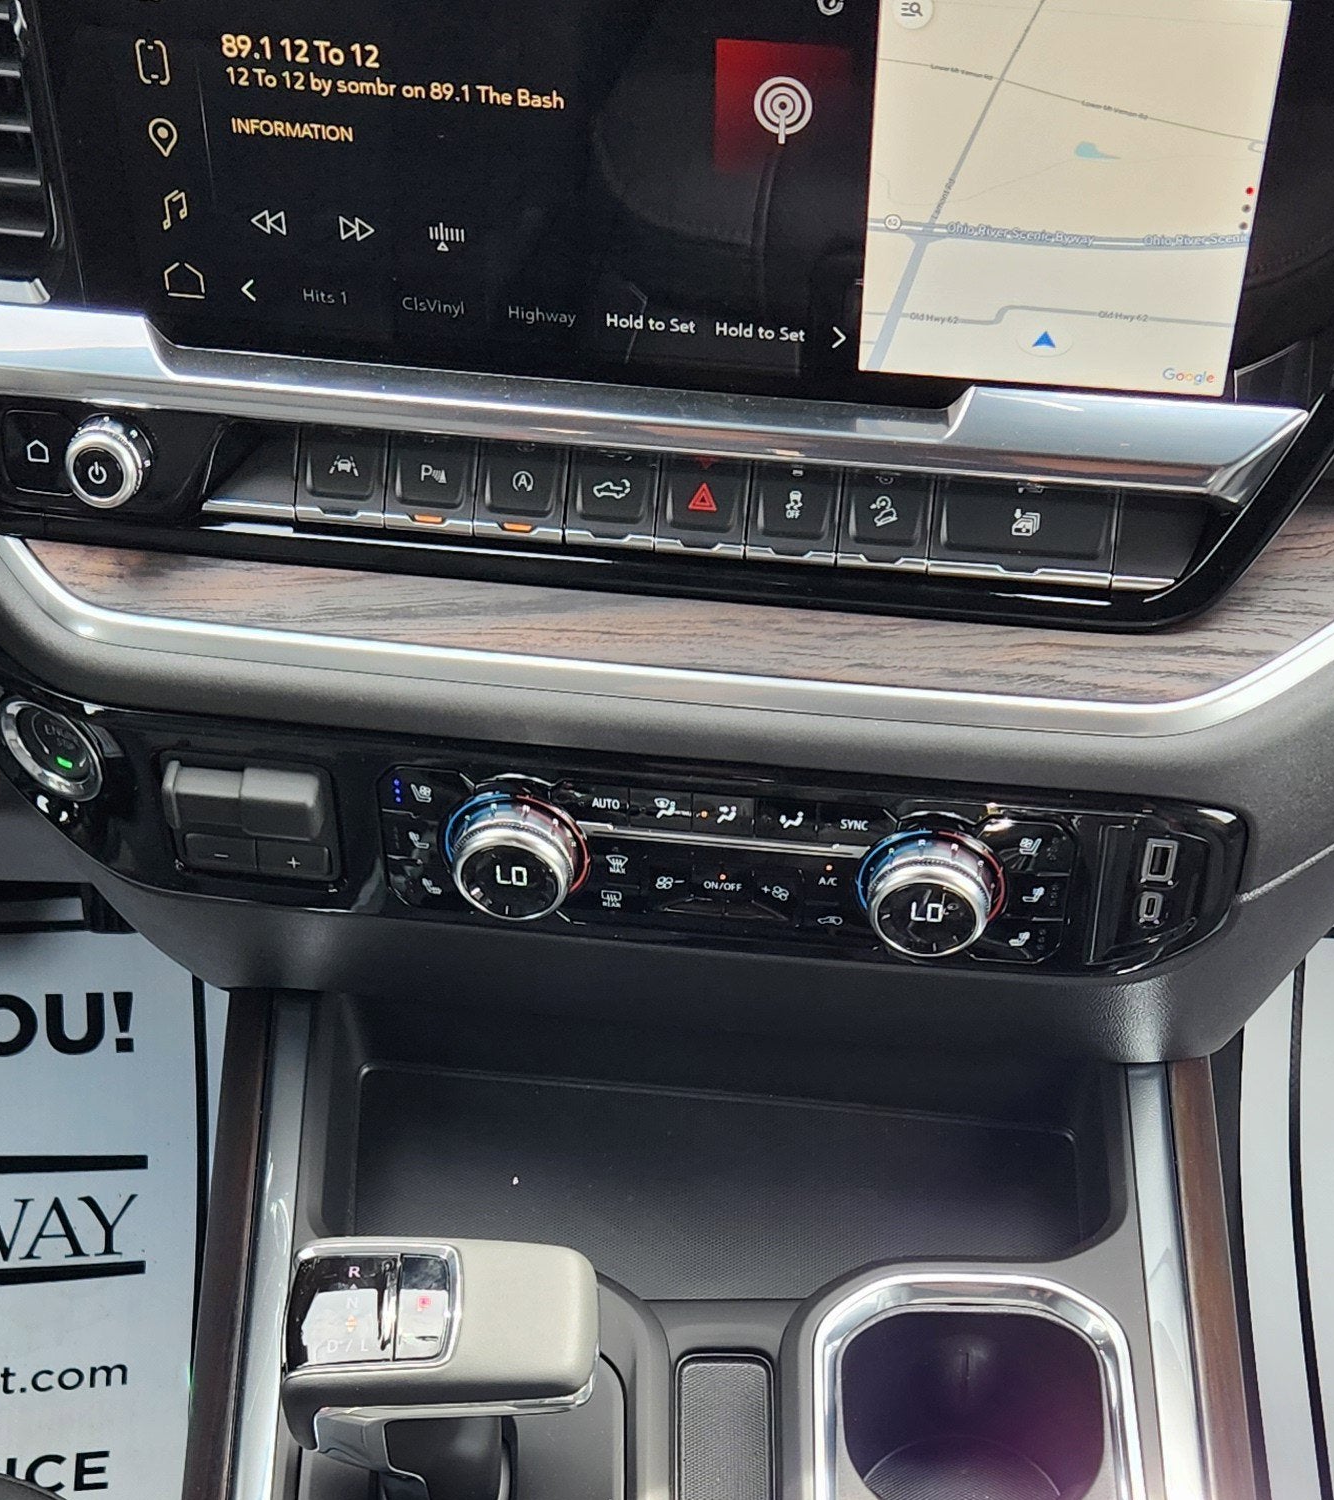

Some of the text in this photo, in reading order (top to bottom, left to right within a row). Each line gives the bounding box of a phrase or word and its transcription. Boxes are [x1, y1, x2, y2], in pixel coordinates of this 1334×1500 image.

[221, 33, 380, 68] 89.1 12 To 12
[225, 66, 564, 110] 12 To 12 by sombr on 89.1 The Bash
[230, 117, 354, 142] INFORMATION
[947, 221, 1095, 246] Ohio River Scenic Byway
[1143, 234, 1173, 246] Ohio
[1175, 234, 1208, 247] River
[303, 288, 348, 305] Hits 1
[402, 297, 465, 318] ClsVinyl
[508, 305, 577, 328] Highway
[605, 312, 696, 334] Hold to Set
[716, 322, 806, 343] Hold to Set
[1162, 367, 1215, 386] Google
[785, 509, 800, 519] OFF
[591, 796, 621, 811] AUTO
[840, 817, 869, 833] SYNC
[704, 880, 743, 893] ON/OFF
[818, 875, 838, 887] A/C
[348, 1265, 361, 1278] R
